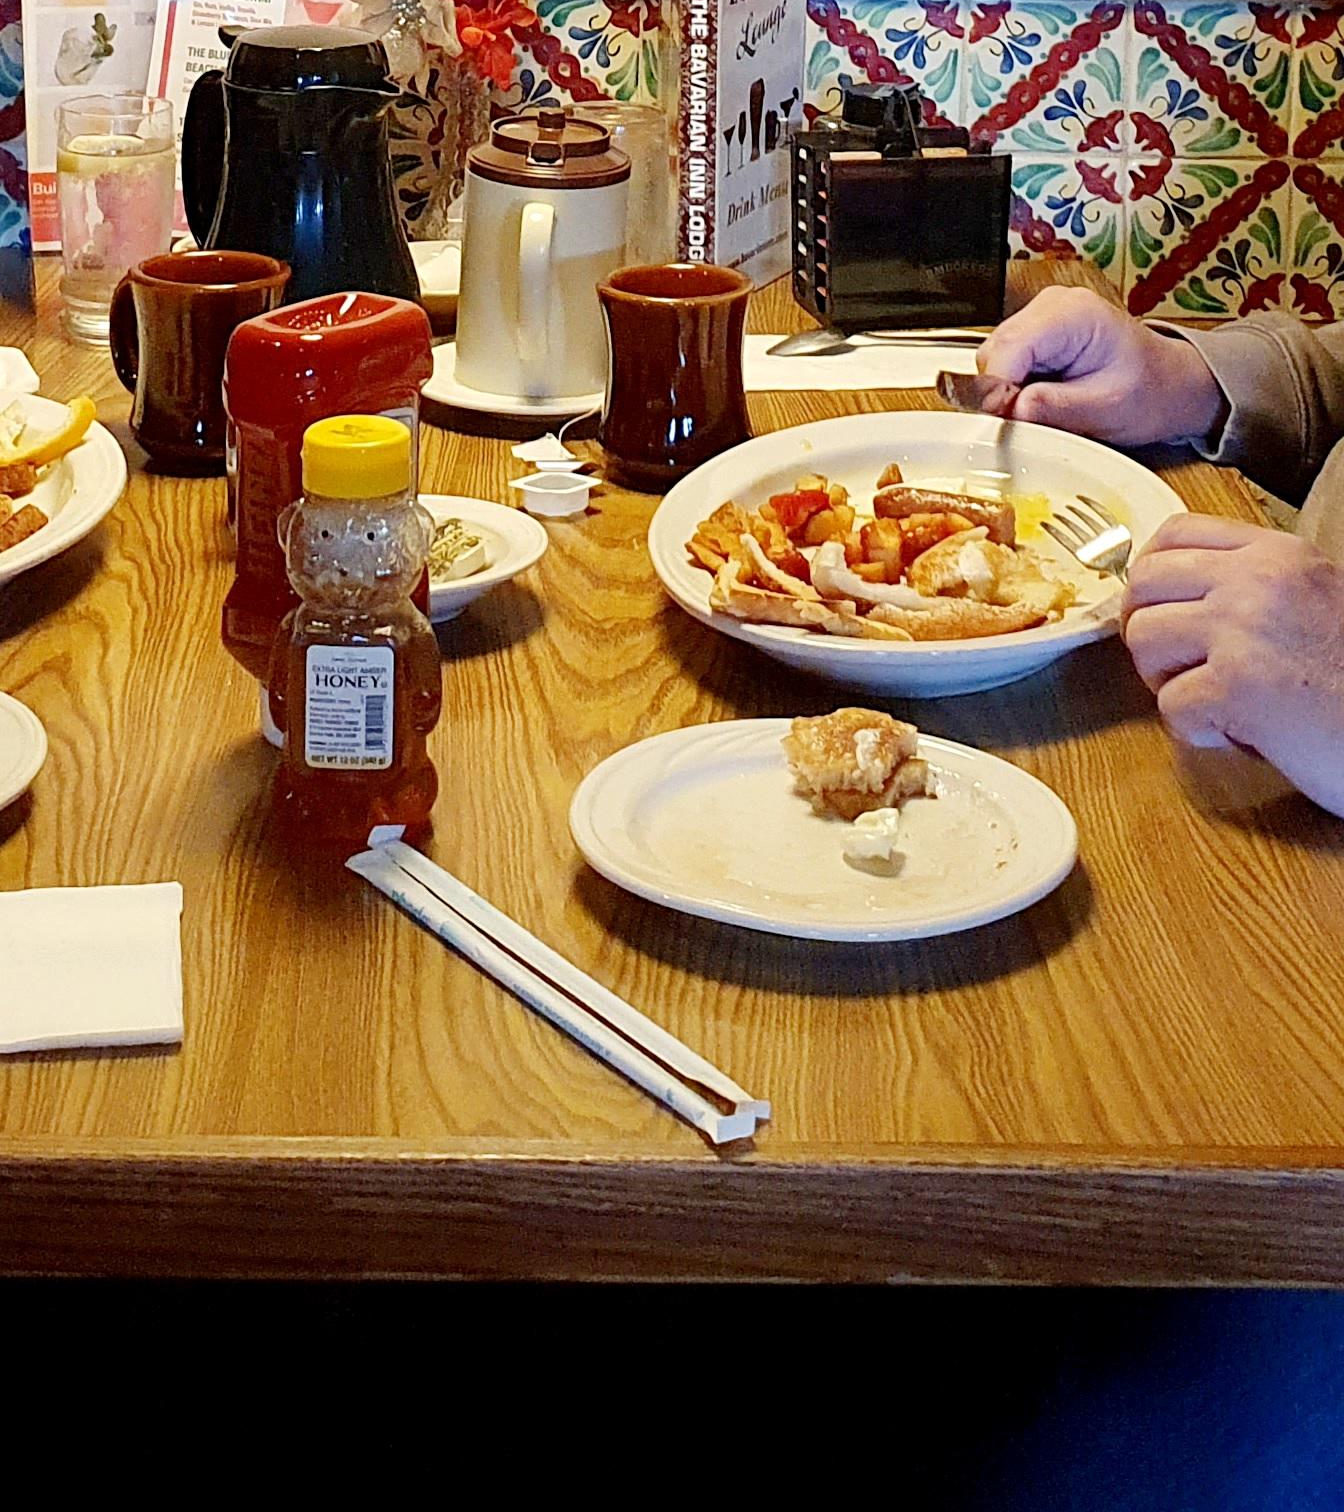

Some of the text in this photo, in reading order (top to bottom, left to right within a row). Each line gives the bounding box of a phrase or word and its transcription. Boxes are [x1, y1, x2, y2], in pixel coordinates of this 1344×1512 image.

[736, 0, 787, 60] Lounge
[187, 46, 230, 60] THE BLU
[689, 43, 708, 152] BAVARIAN
[688, 157, 706, 199] INN
[727, 190, 755, 227] Drink
[688, 204, 706, 263] LODG
[312, 665, 335, 673] EXTRA
[360, 667, 387, 675] AMBER
[315, 674, 380, 688] HONEY
